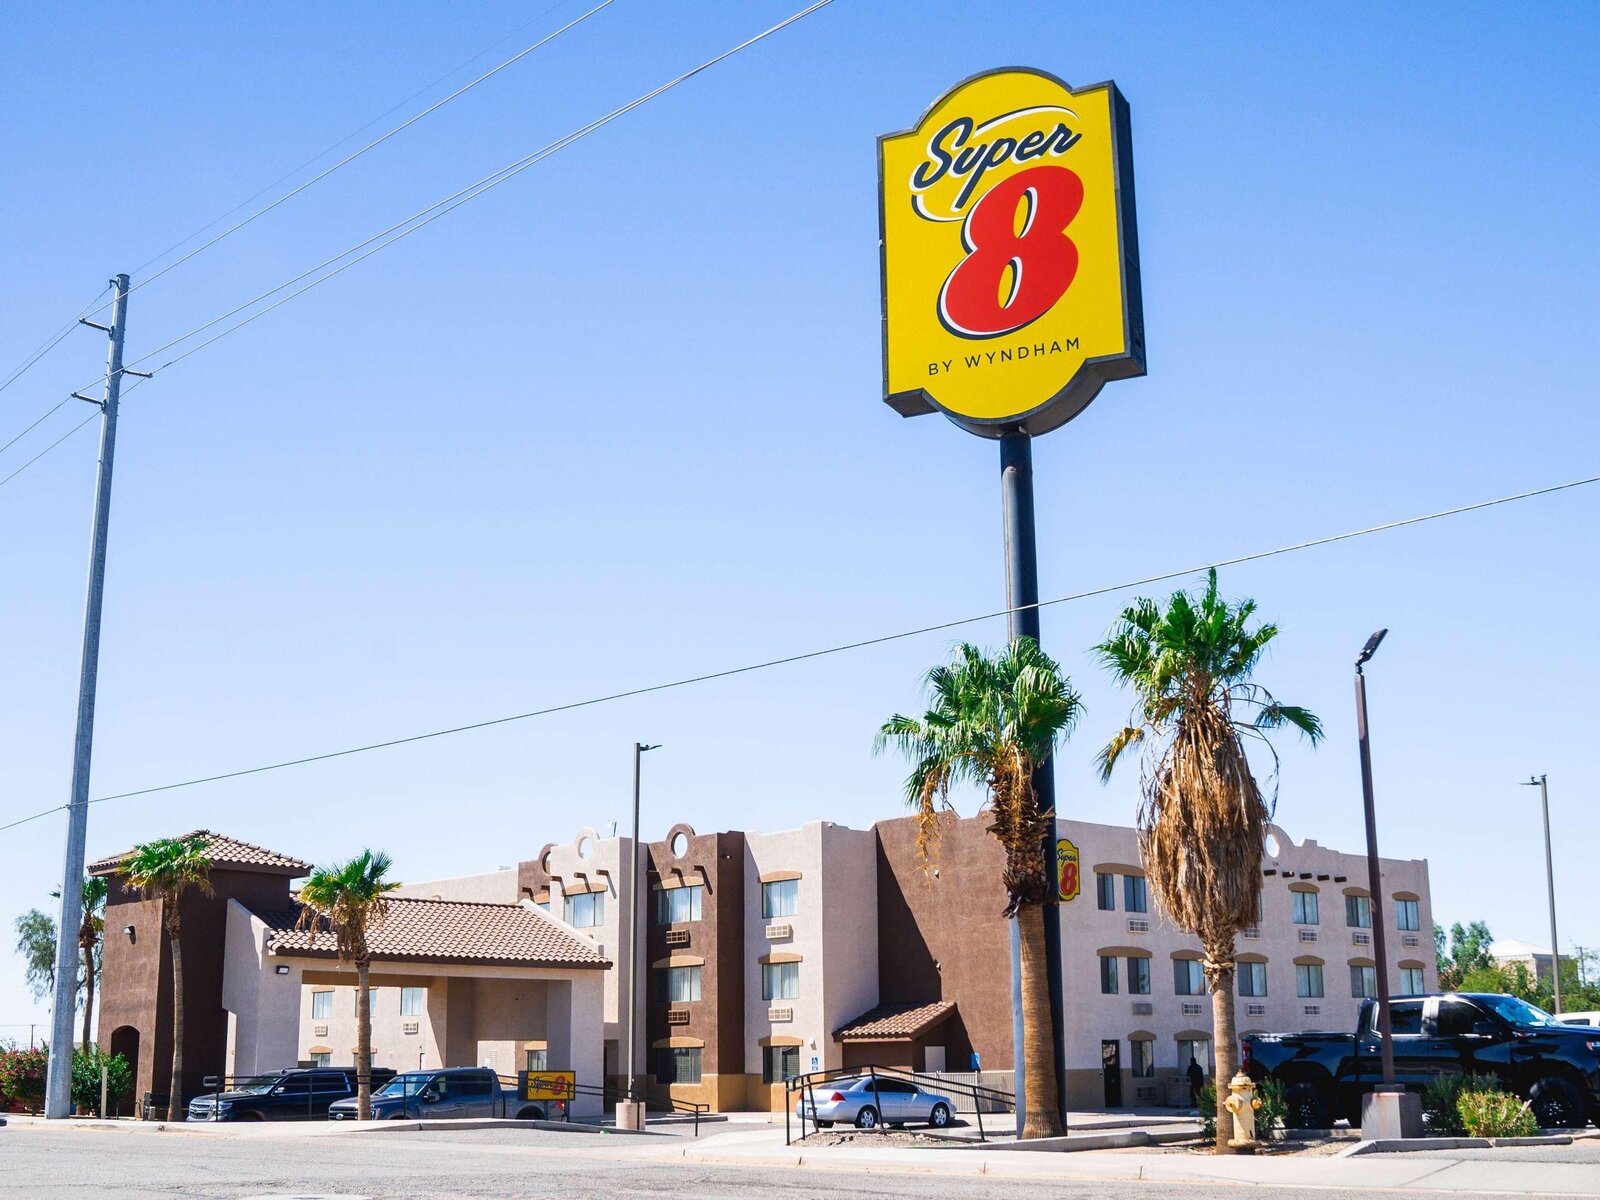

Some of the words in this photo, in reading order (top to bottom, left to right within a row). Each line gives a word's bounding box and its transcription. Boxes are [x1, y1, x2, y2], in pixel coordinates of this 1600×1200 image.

[909, 116, 1083, 212] Super
[936, 165, 1084, 340] 8
[928, 360, 952, 376] BY
[964, 337, 1080, 368] WYNDHAM
[1059, 862, 1077, 896] 8
